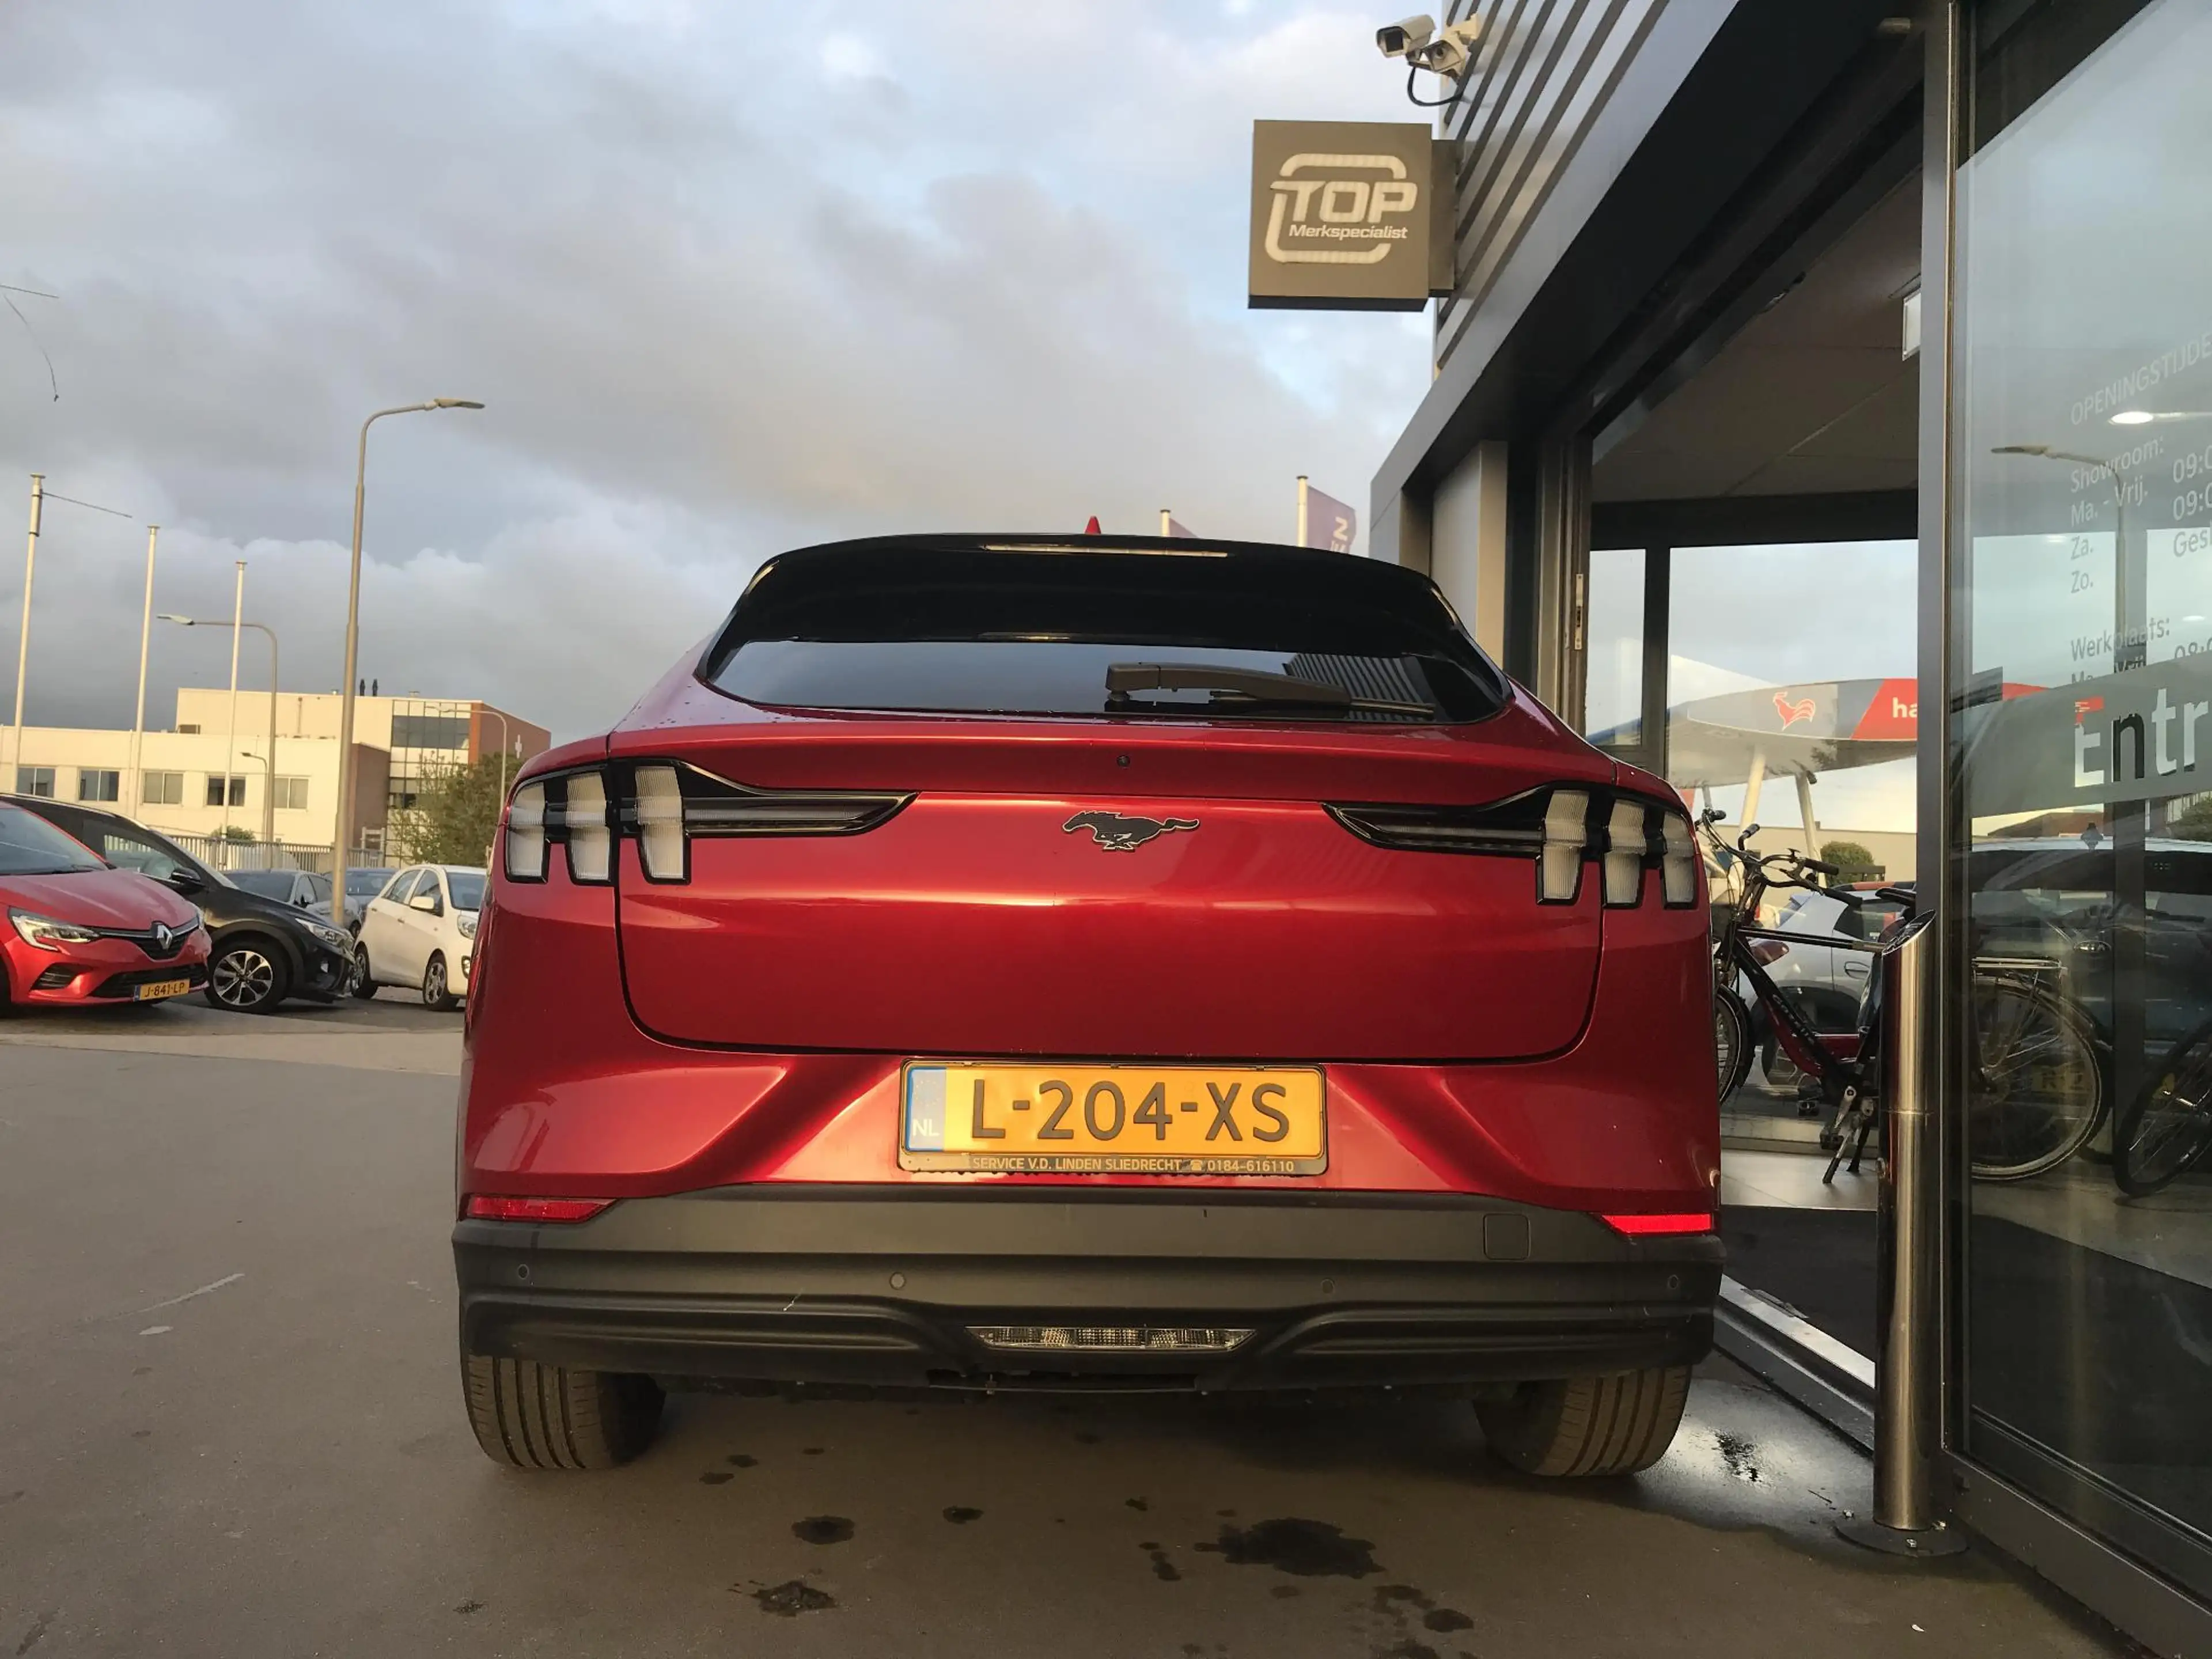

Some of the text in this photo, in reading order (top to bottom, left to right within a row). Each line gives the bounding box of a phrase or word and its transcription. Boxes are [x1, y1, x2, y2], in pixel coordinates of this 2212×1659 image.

[1270, 180, 1418, 224] TOP
[1289, 224, 1408, 241] Merkspecialist
[2070, 331, 2212, 426] OPENINGSTIJDE
[2070, 435, 2164, 493] Showroom:
[2070, 500, 2098, 528] Ma.
[2114, 475, 2149, 507] Vrij.
[2070, 535, 2094, 560] Za.
[2070, 570, 2094, 594] Zo.
[2070, 617, 2171, 662] Werkplaats:
[2074, 688, 2209, 787] Entr
[144, 982, 185, 998] J-841-LP
[912, 1118, 940, 1137] NL
[971, 1078, 1290, 1143] L-204-XS
[972, 1157, 1294, 1172] SERVICE V.D. LINDEN SLIEDRECHT 0184-616110
